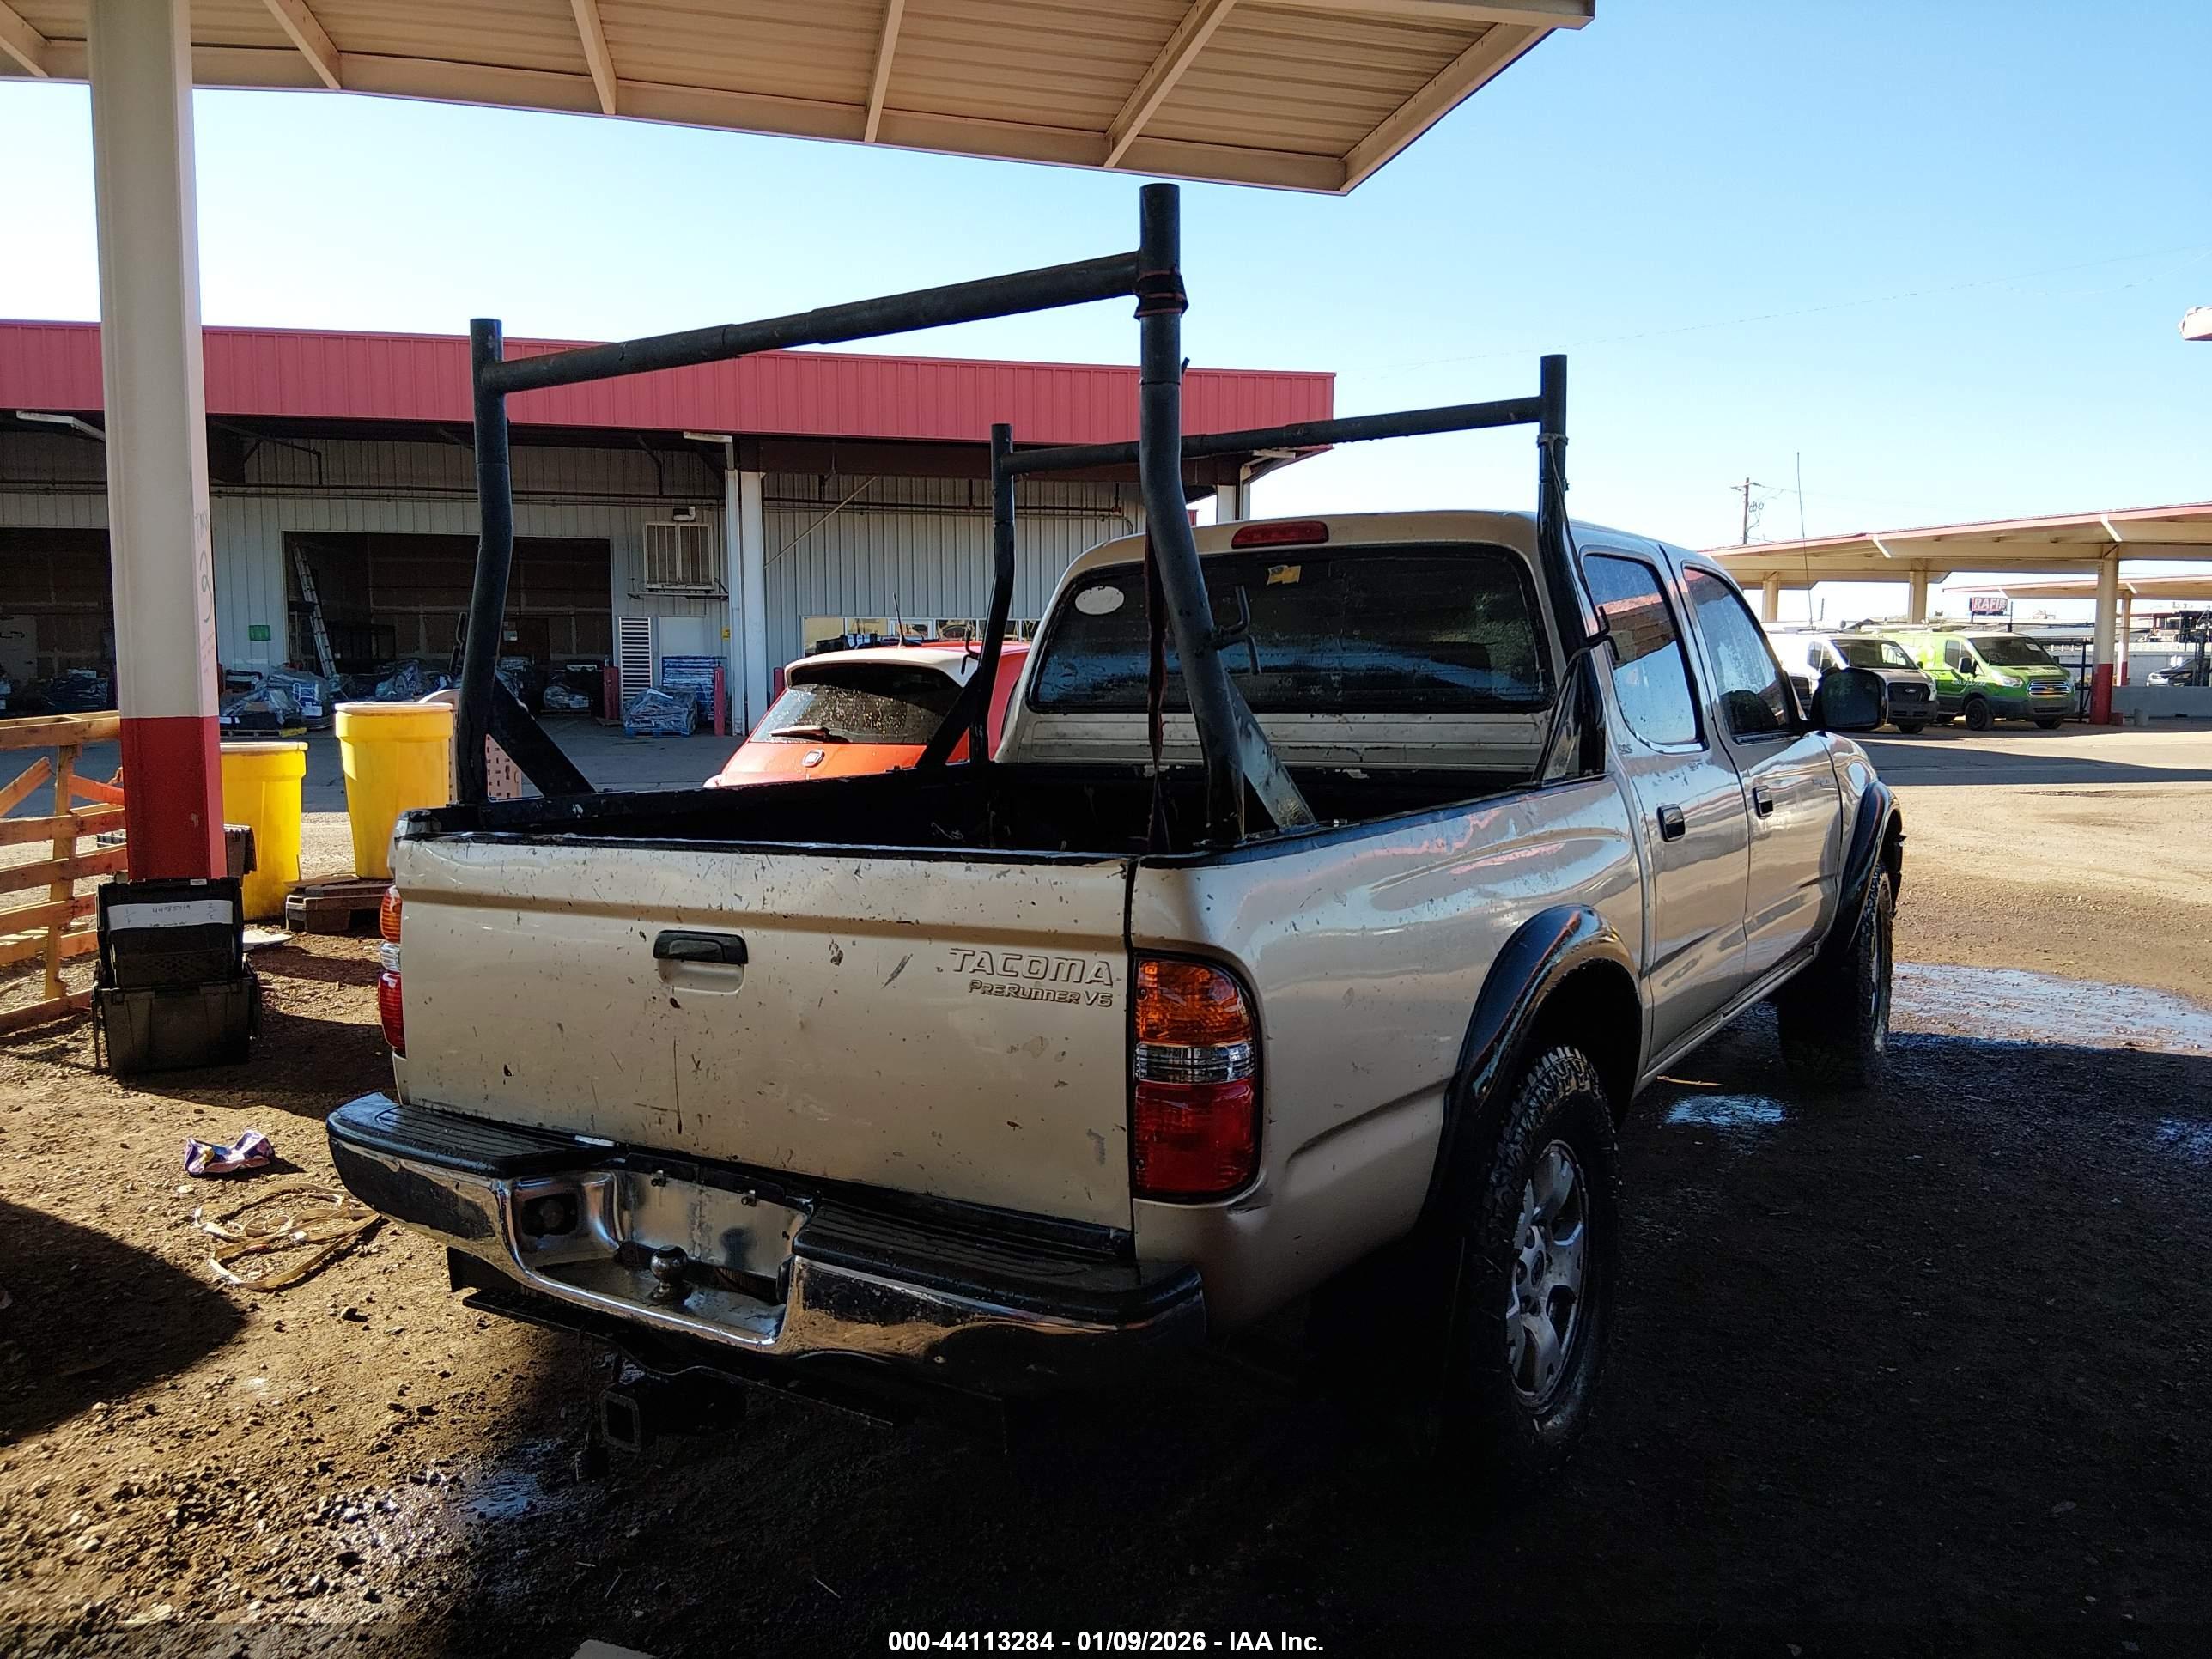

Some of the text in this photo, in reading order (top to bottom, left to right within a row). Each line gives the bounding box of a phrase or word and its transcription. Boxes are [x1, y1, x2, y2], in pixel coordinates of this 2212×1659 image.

[1974, 598, 1999, 610] RAFI
[949, 948, 1114, 988] TACOMA
[1084, 990, 1113, 1007] V6
